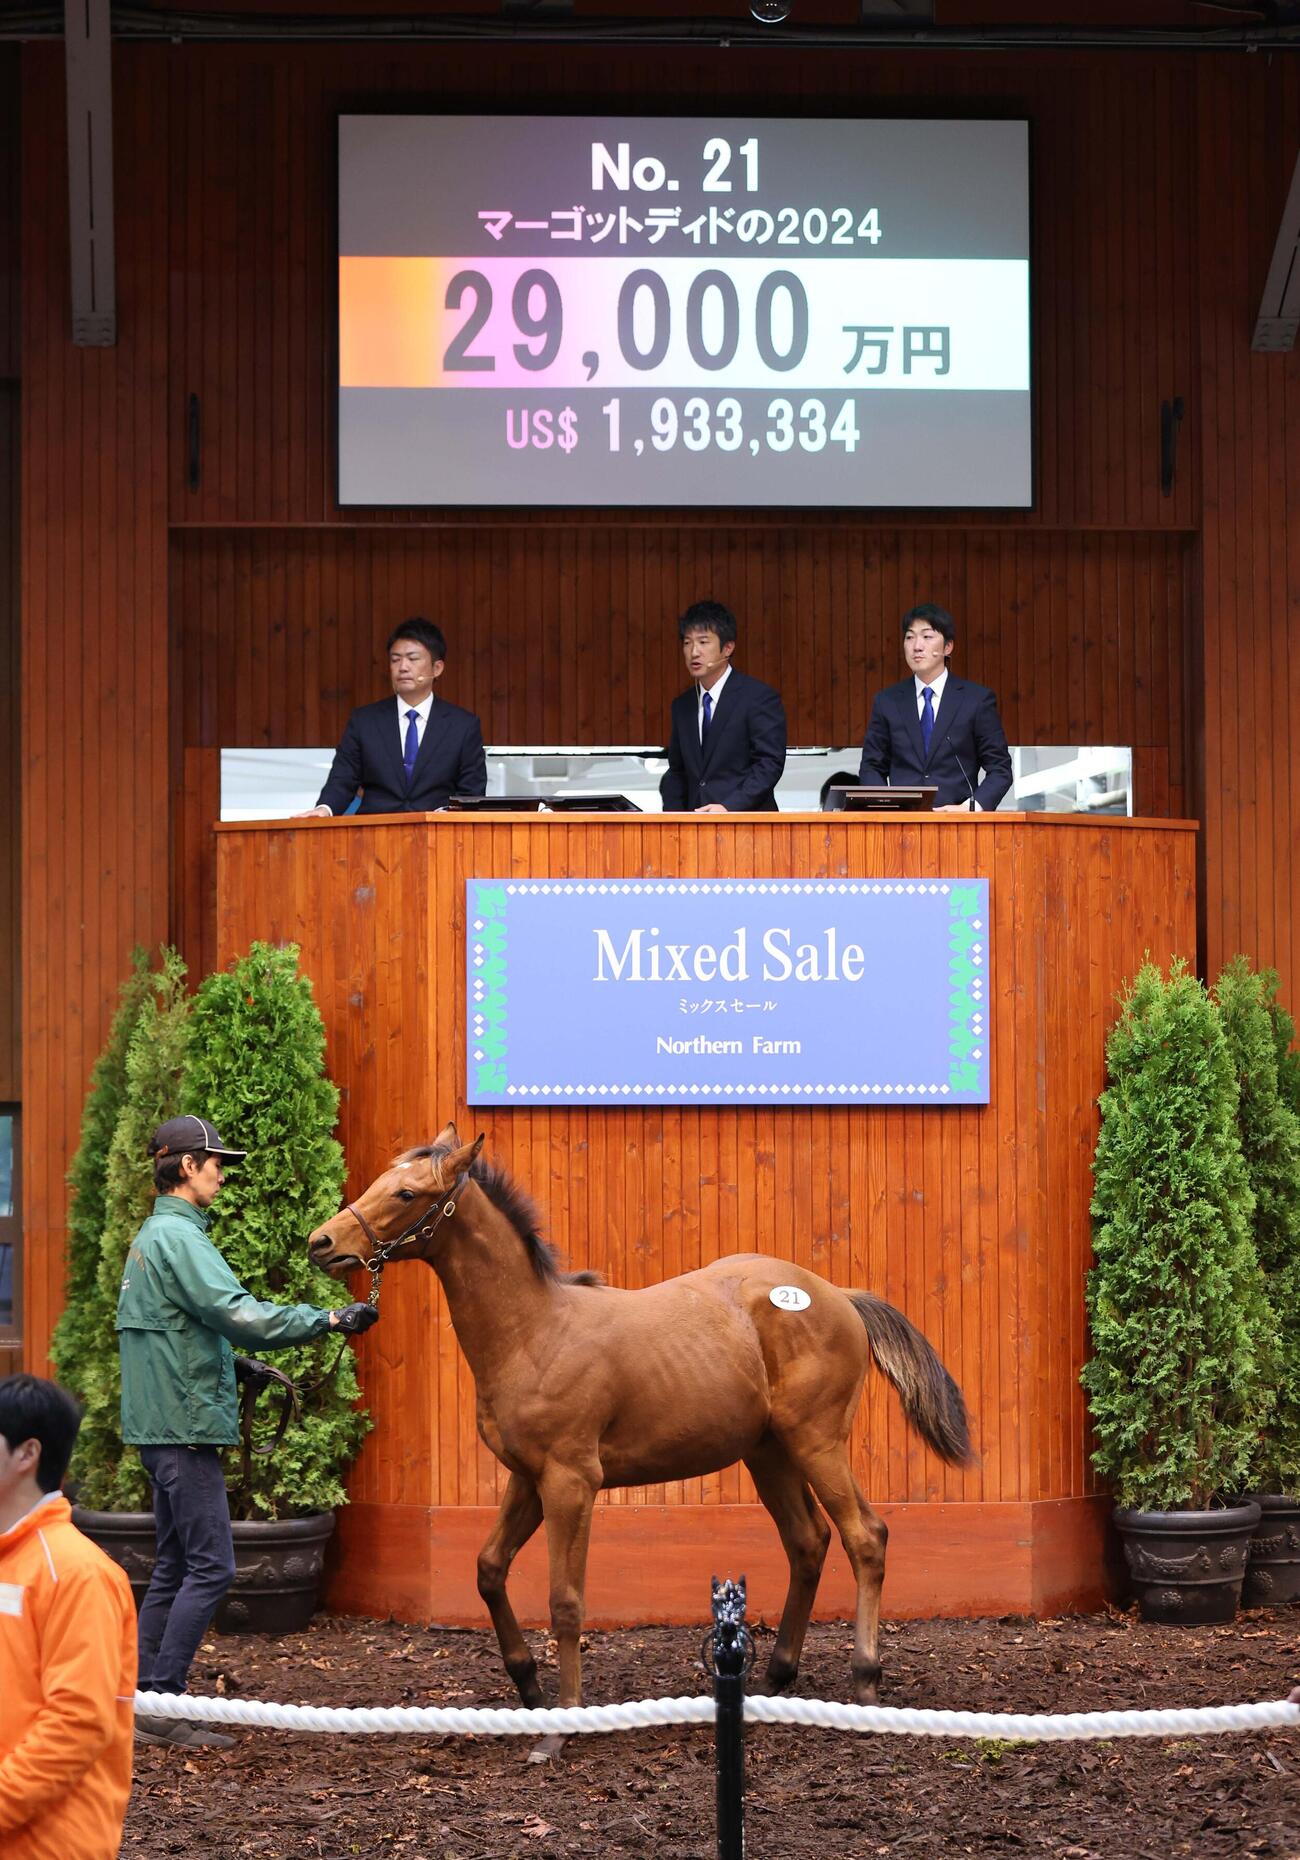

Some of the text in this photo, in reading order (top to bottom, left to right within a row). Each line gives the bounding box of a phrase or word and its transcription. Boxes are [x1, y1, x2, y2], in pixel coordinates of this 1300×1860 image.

[591, 137, 759, 192] No. 21
[478, 205, 882, 245] マーゴットディドの2024
[443, 268, 951, 382] 29,000 万円
[506, 397, 860, 457] US$ 1,933,334
[592, 927, 865, 982] Mixed Sale
[679, 998, 778, 1014] ミックスセール
[656, 1035, 801, 1054] Northern Farm
[779, 1290, 800, 1304] 21
